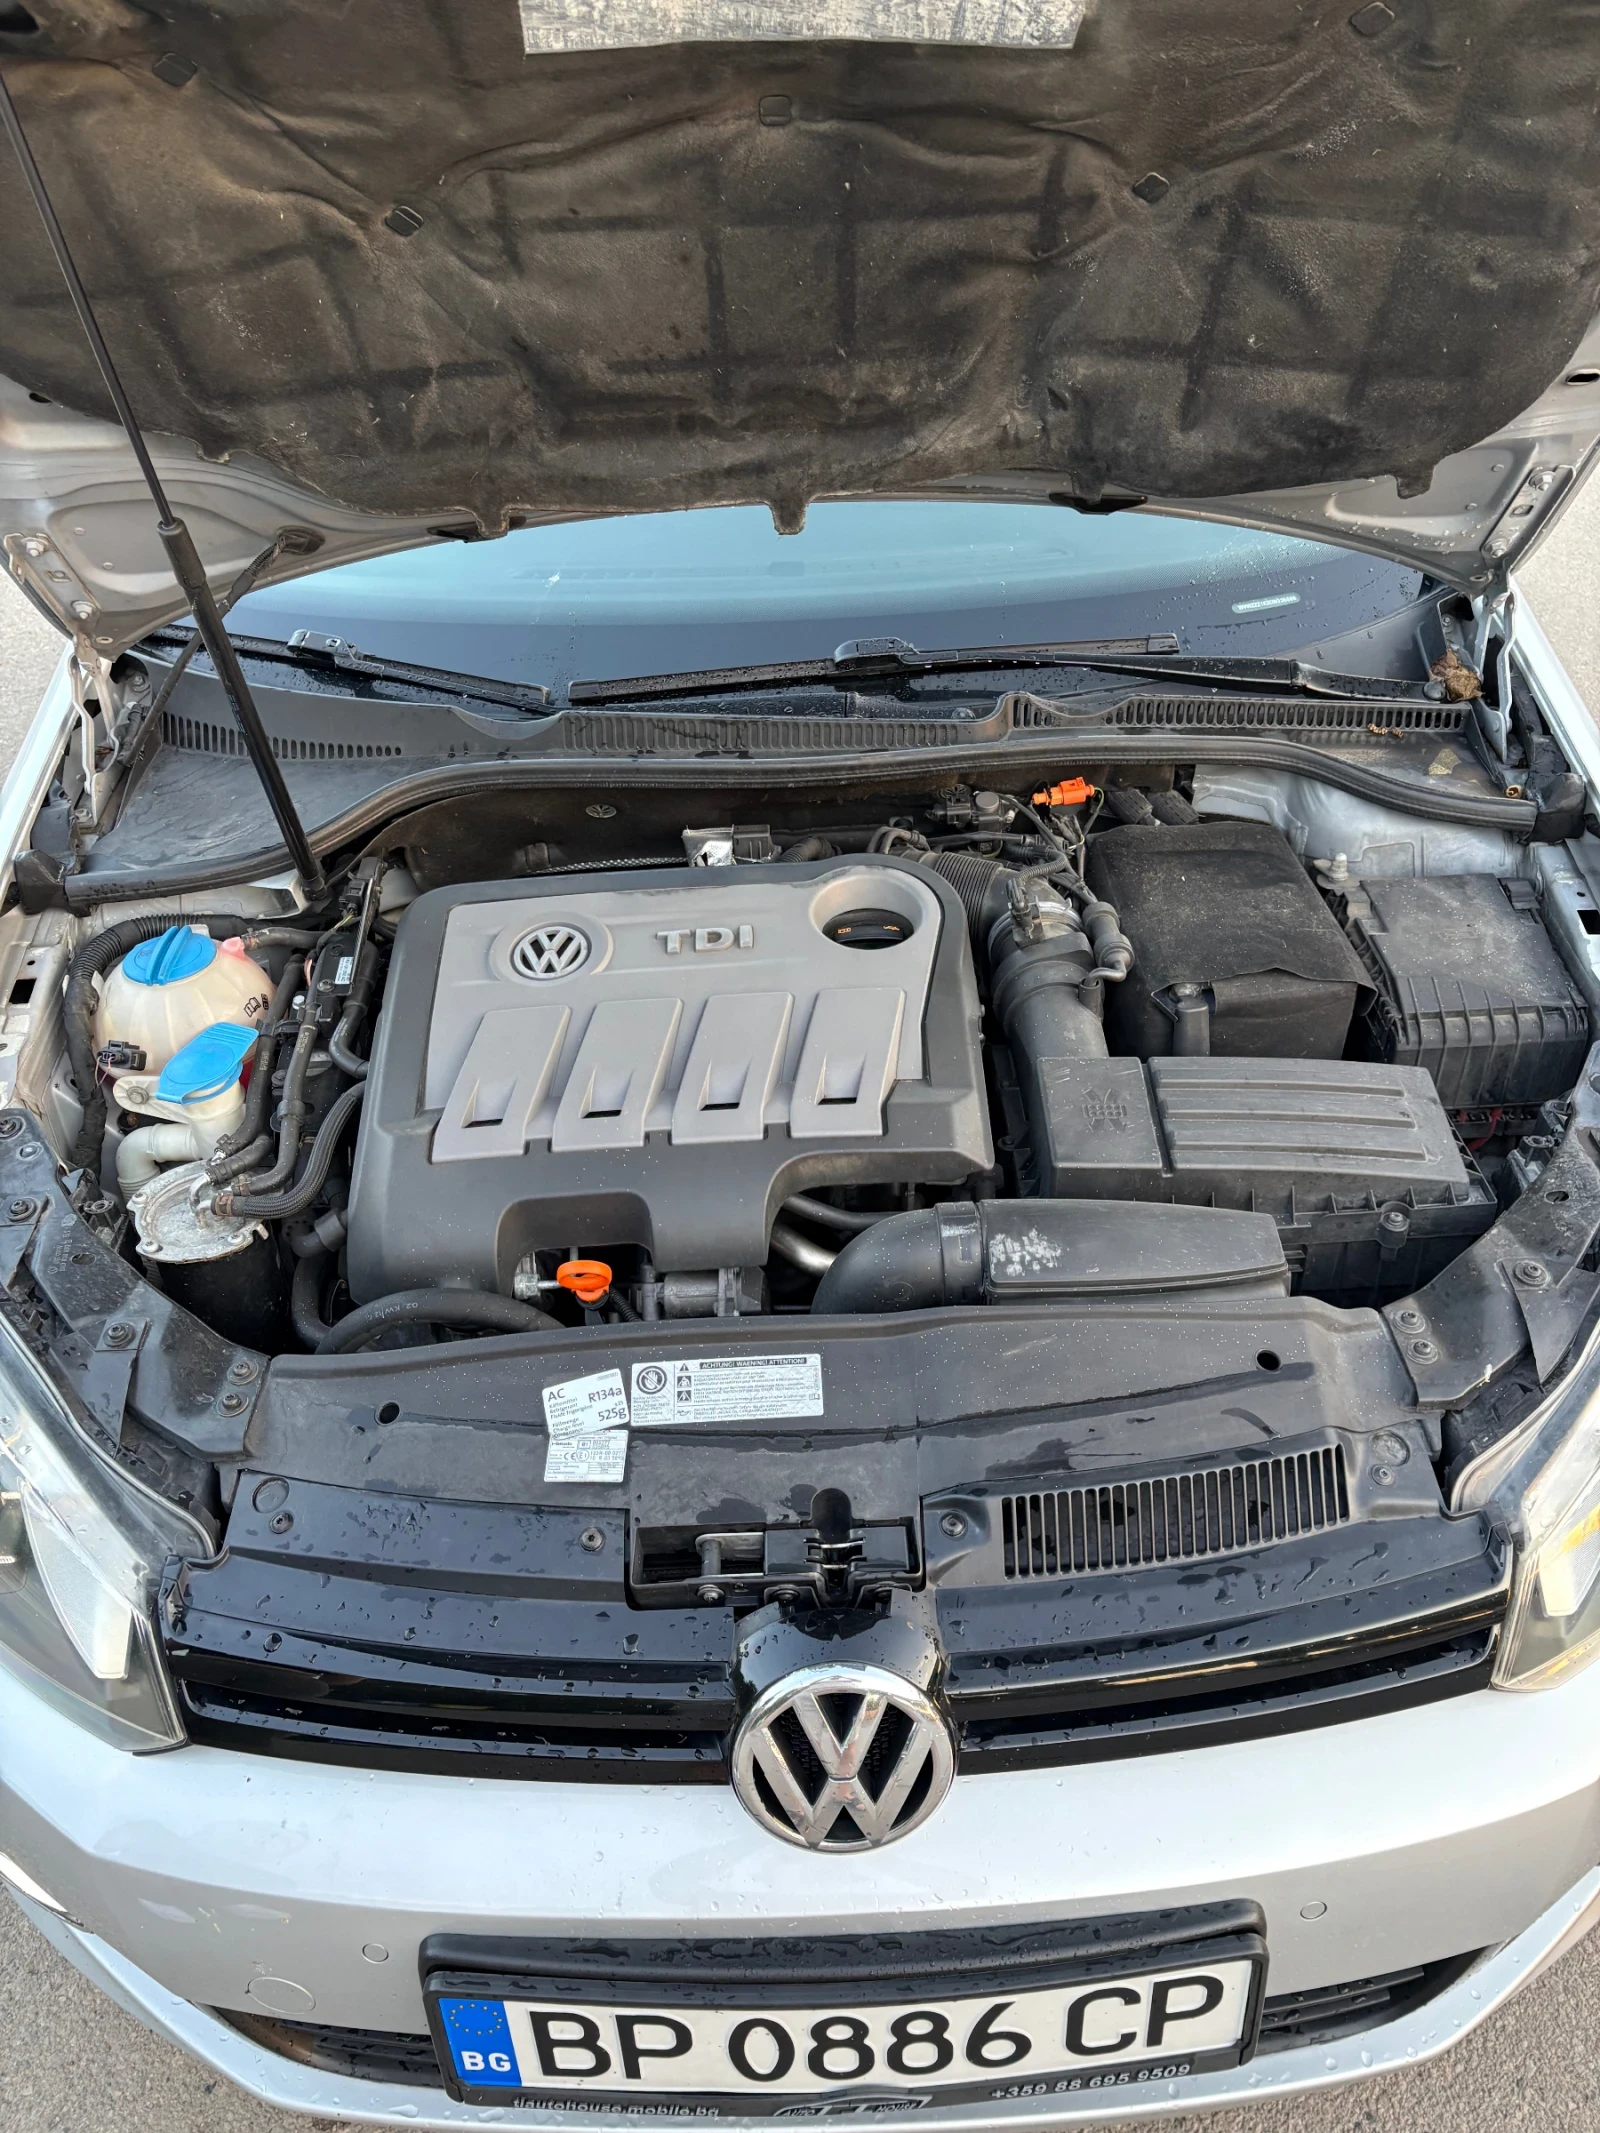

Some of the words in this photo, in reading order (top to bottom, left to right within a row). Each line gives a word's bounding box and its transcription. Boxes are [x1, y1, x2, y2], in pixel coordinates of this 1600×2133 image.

[656, 924, 754, 955] TDI
[514, 926, 588, 981] VW
[701, 1361, 736, 1369] ACHTUNG!
[736, 1359, 768, 1367] WARNING!
[547, 1387, 566, 1402] AC
[588, 1387, 623, 1403] R134a
[597, 1407, 627, 1422] 525g
[736, 1668, 950, 1850] VW
[528, 2009, 692, 2082] BP
[728, 2000, 1032, 2082] 0886
[1064, 1976, 1225, 2056] CP
[460, 2051, 511, 2073] BG
[991, 2083, 1047, 2099] +359
[1054, 2078, 1082, 2093] 88
[1089, 2072, 1131, 2089] 695
[1136, 2064, 1191, 2083] 9509
